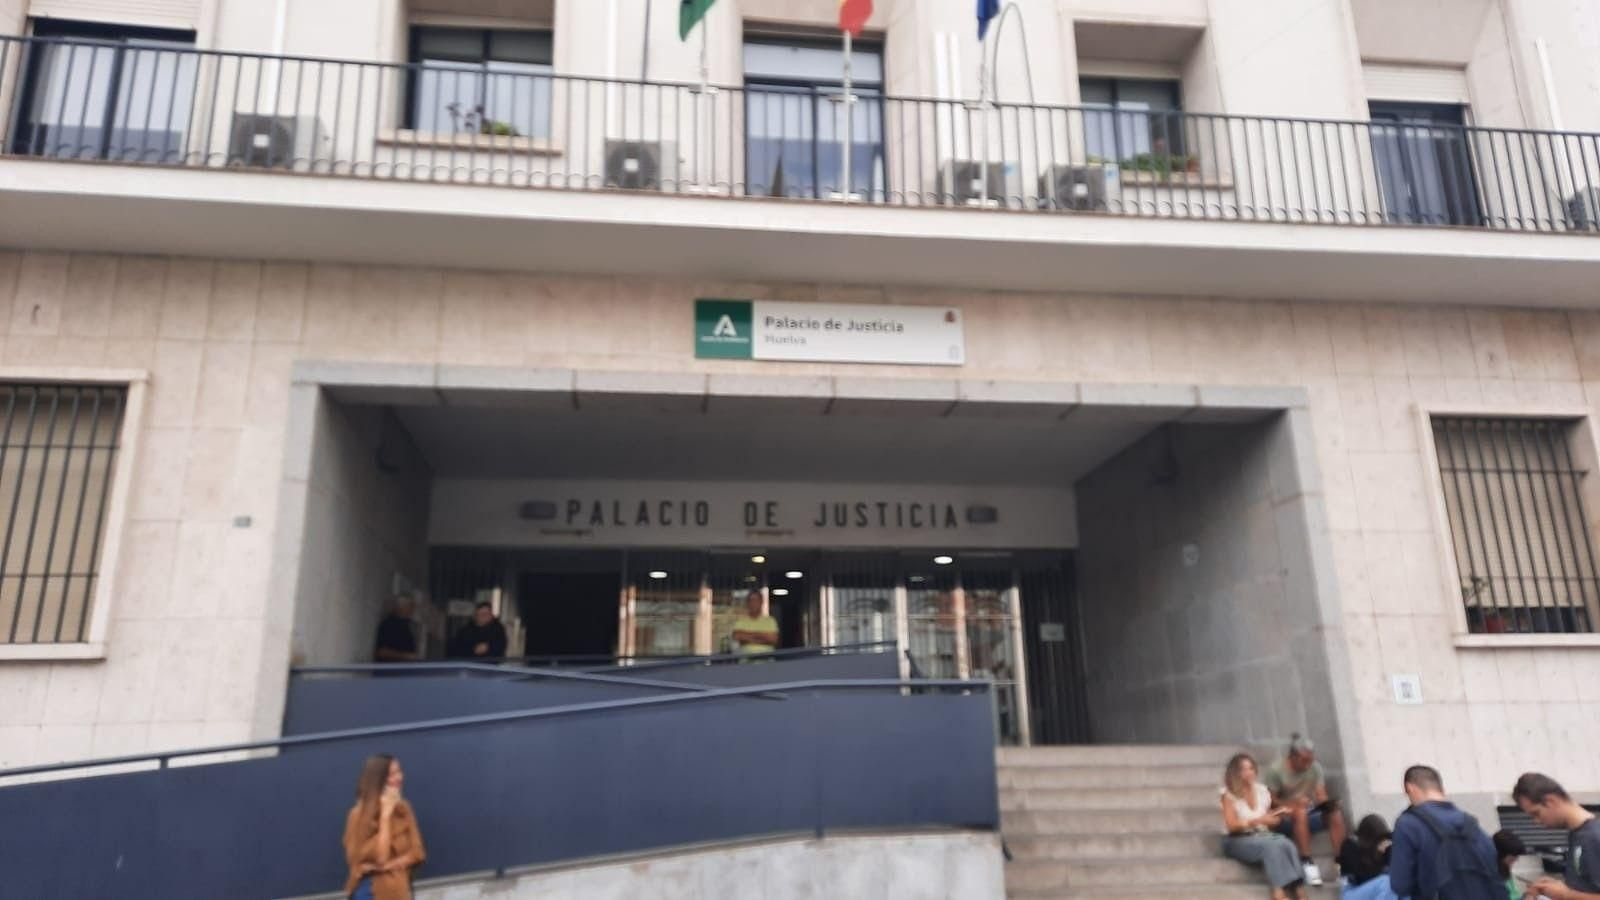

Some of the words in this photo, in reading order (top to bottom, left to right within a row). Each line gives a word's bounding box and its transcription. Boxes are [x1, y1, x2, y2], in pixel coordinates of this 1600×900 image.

[764, 315, 821, 330] Palacio
[824, 316, 842, 331] de
[847, 319, 905, 333] Justicia
[764, 335, 808, 346] Huelva
[565, 499, 710, 527] PALACIO
[743, 500, 780, 528] DE
[813, 501, 959, 529] JUSTICIA
